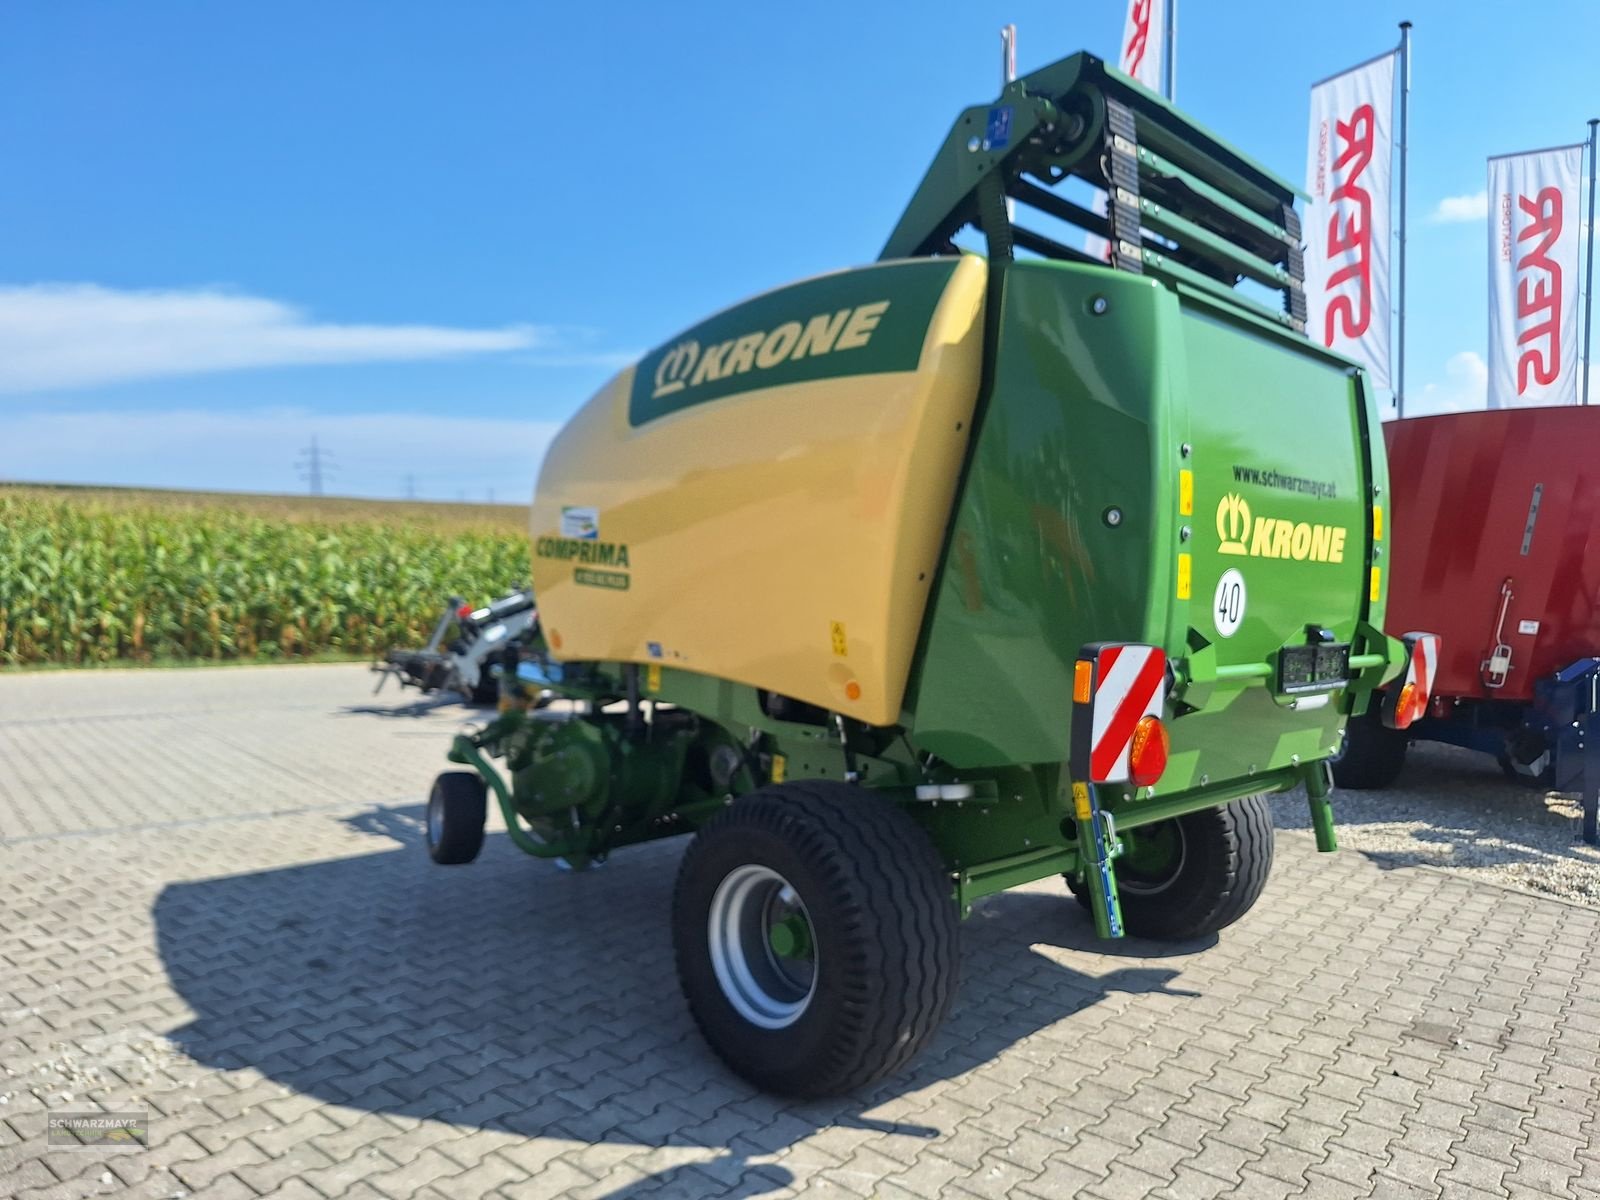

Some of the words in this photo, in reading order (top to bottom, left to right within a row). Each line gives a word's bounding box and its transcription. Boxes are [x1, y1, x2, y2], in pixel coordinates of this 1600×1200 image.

[690, 300, 890, 387] KRONE
[1232, 464, 1337, 500] www.schwarzmayr.at
[536, 536, 630, 568] COMPRIMA
[1250, 517, 1347, 564] KRONE
[1219, 582, 1241, 623] 40
